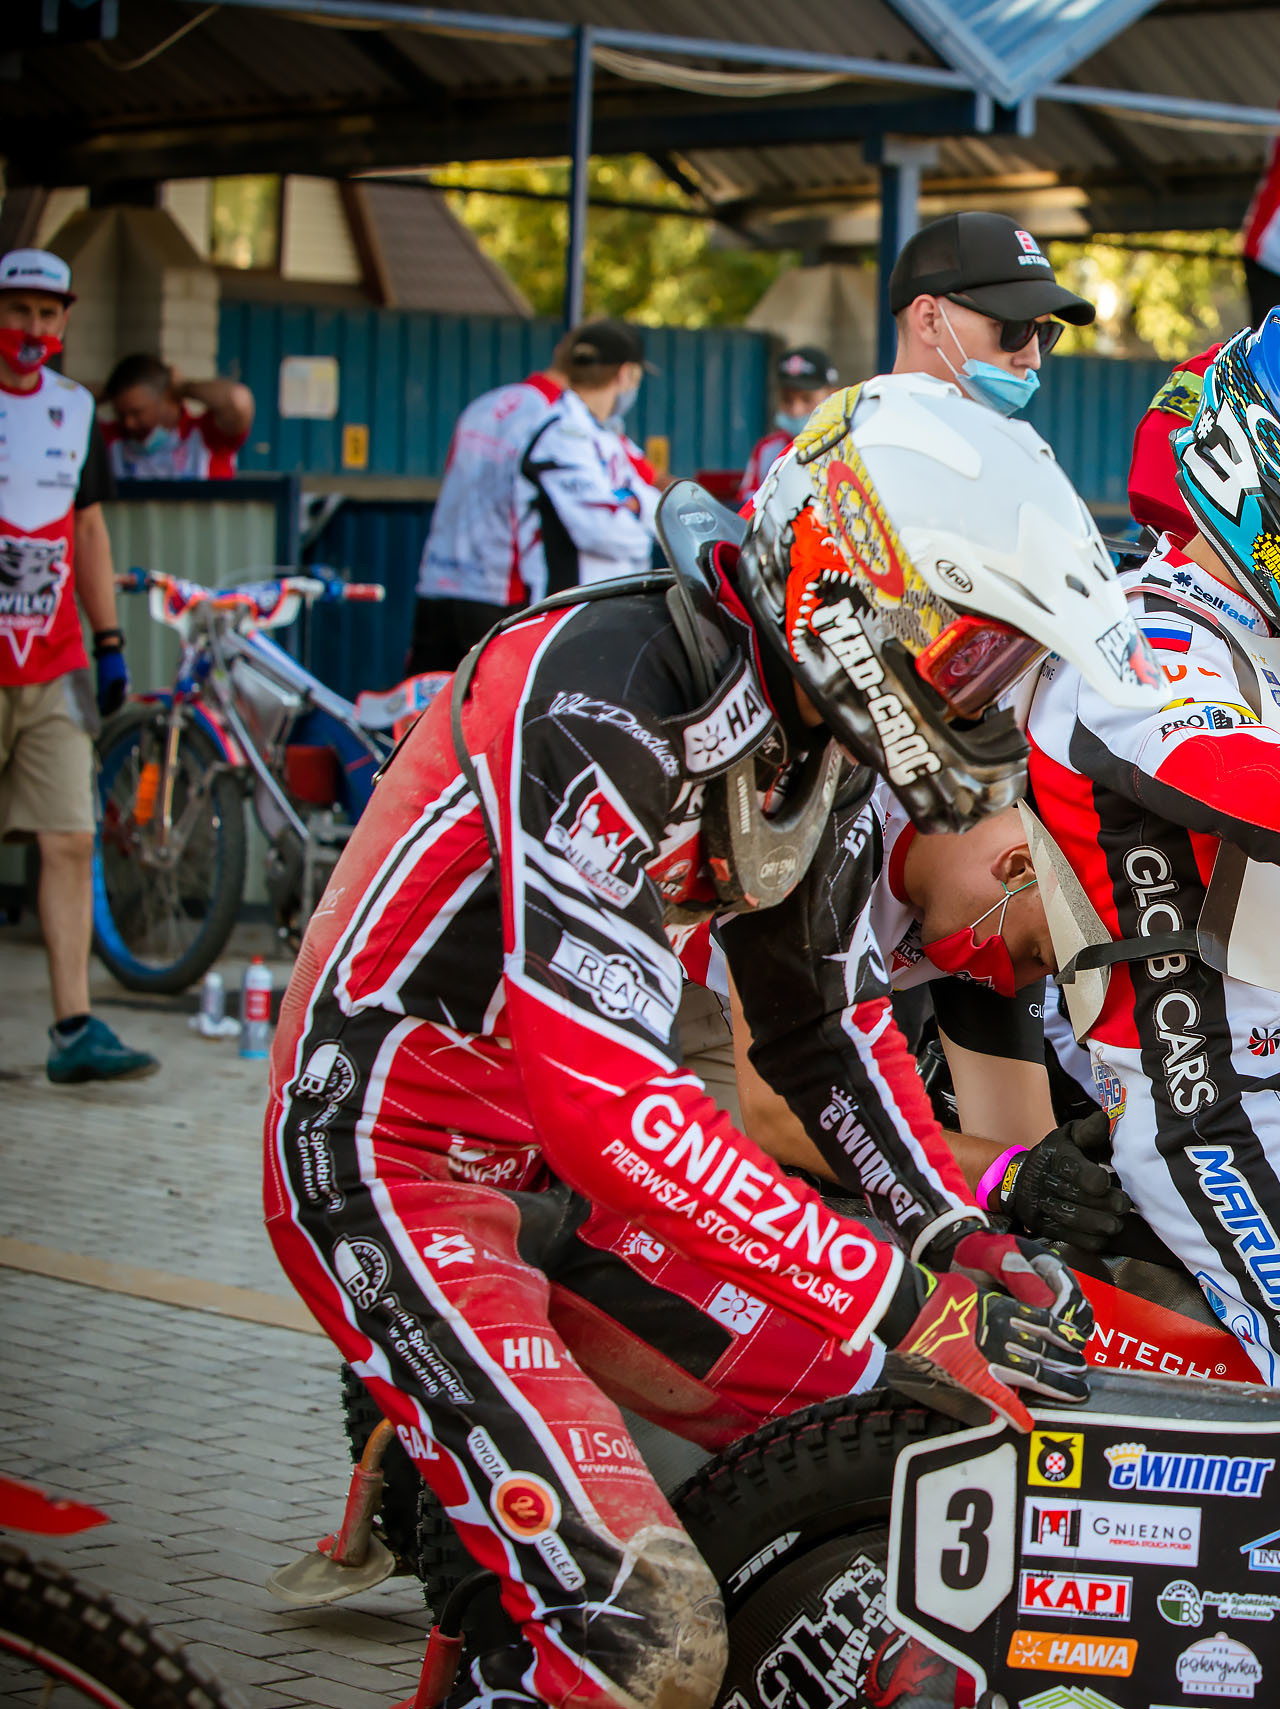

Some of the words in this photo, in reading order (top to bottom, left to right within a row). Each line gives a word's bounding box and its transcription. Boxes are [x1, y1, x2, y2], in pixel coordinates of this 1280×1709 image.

[1193, 585, 1256, 630] cellfast
[811, 597, 943, 786] MAD-CROC
[1160, 715, 1204, 738] PRO
[1156, 993, 1215, 1115] CARS
[631, 1094, 877, 1281] GNIEZNO
[601, 1139, 699, 1219] PIERWSZA
[696, 1209, 780, 1273] STOLICA
[779, 1263, 854, 1315] POLSKI
[471, 1432, 504, 1480] TOYOTA
[940, 1488, 994, 1591] 3
[1092, 1517, 1192, 1541] GNIEZNO
[540, 1536, 580, 1587] UKLEJA
[1024, 1577, 1126, 1614] KAPI
[1181, 1601, 1200, 1623] BS
[1048, 1640, 1128, 1670] HAWA
